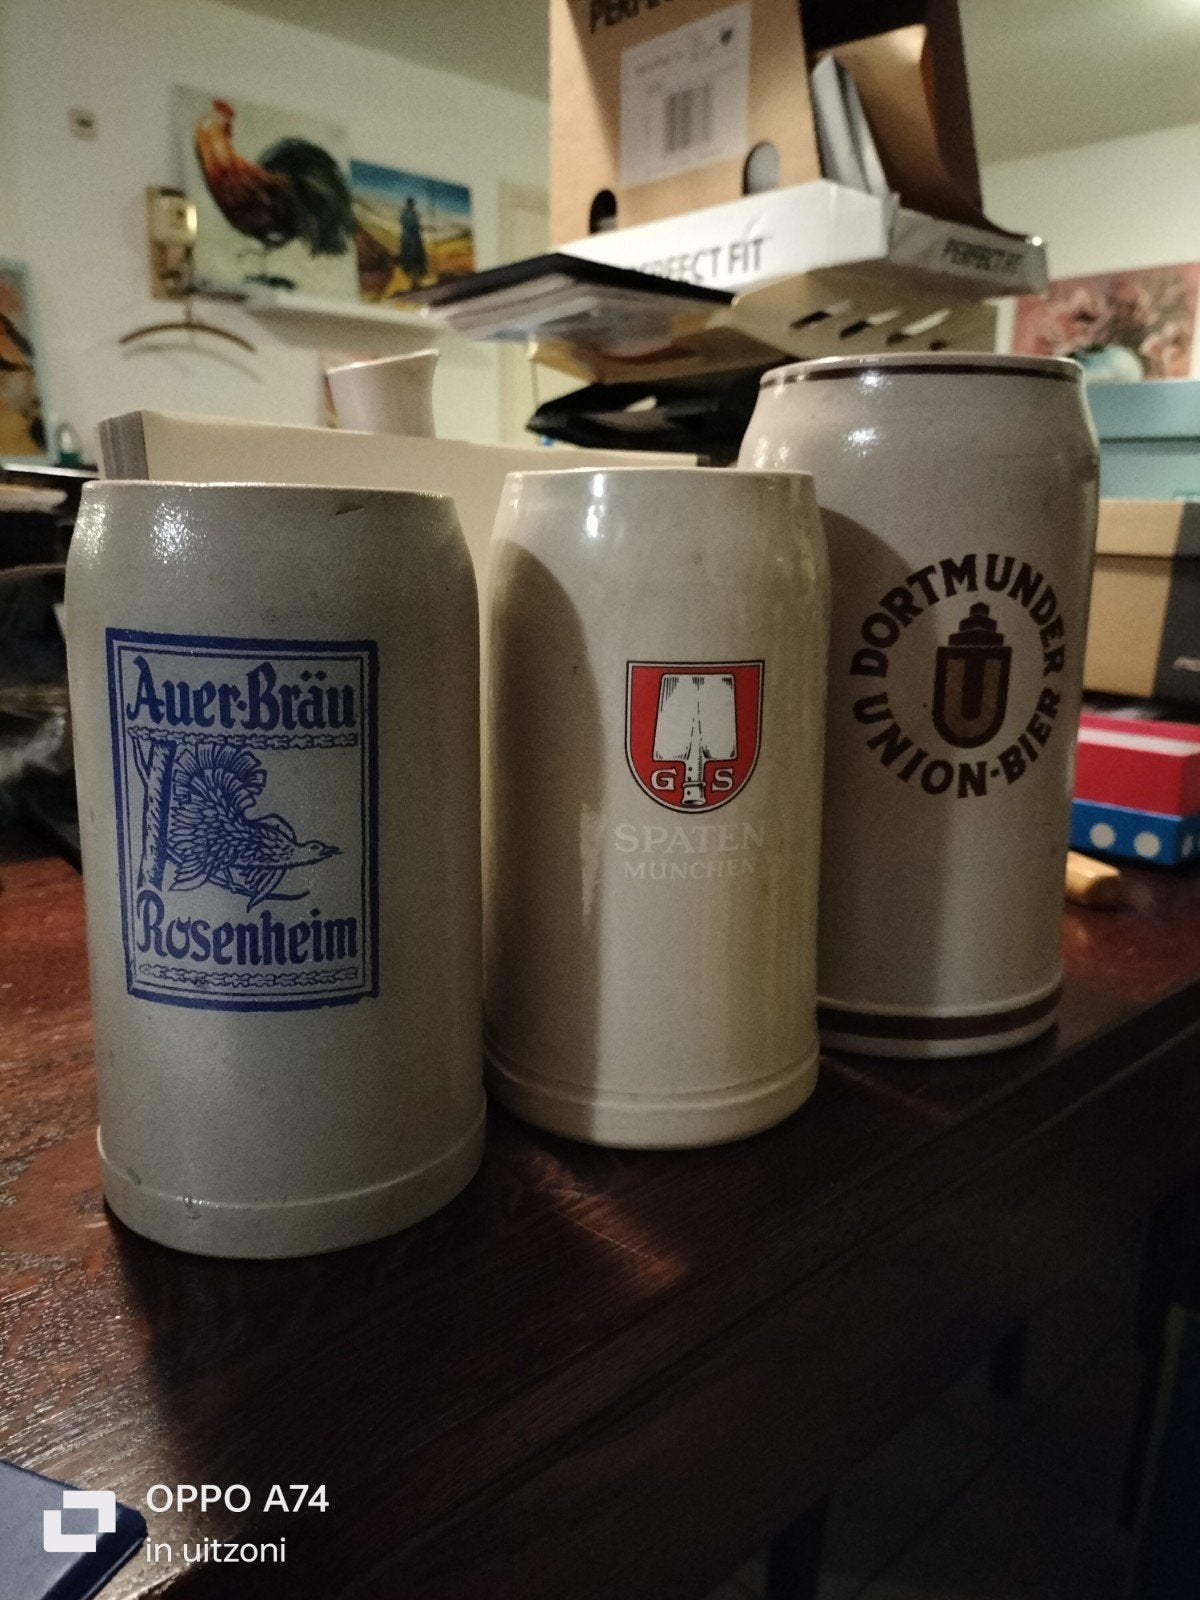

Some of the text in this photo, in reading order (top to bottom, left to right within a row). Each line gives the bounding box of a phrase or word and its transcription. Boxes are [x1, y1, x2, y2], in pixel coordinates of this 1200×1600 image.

[727, 237, 764, 274] FIT
[943, 238, 1006, 271] PERFECT
[850, 553, 1065, 679] DORTMUNDER
[852, 686, 1061, 799] UNION-BIER
[651, 767, 734, 791] G S
[613, 820, 766, 855] SPATEN
[136, 889, 358, 966] Rosenheim
